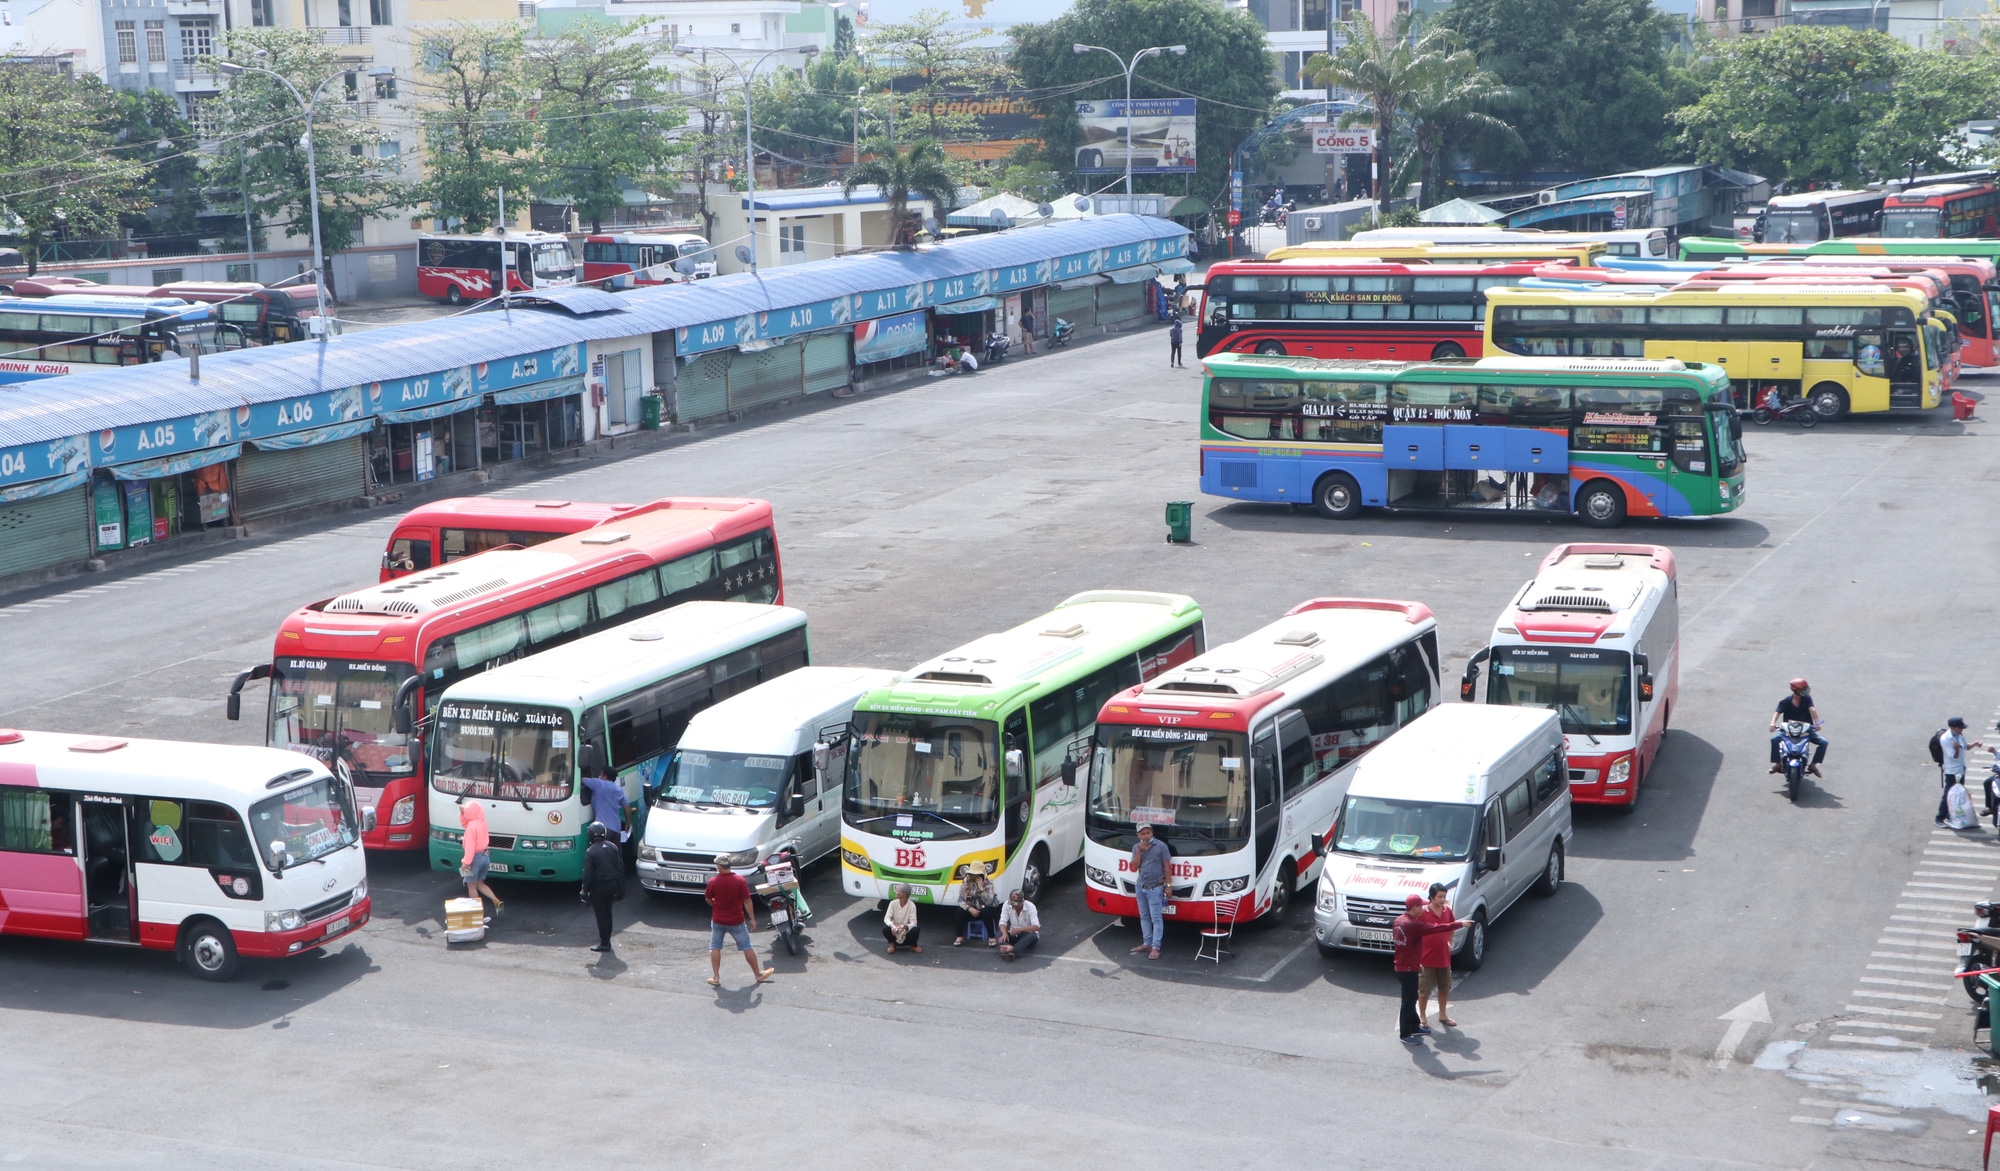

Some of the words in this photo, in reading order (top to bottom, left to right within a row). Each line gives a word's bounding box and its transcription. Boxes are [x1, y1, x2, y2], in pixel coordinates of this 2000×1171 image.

[1316, 133, 1355, 147] CỔNG
[1359, 136, 1369, 147] 5
[1117, 250, 1131, 264] A.15
[1067, 259, 1082, 274] A.14
[1010, 268, 1027, 285] A.13
[945, 280, 964, 298] A.12
[1330, 292, 1356, 301] KHÁCH
[877, 292, 896, 311] A.11
[790, 308, 812, 329] A.10
[702, 324, 725, 345] A.09
[0, 362, 29, 372] MINH
[35, 364, 69, 375] NGHĨA
[402, 379, 429, 402] A.07
[277, 400, 313, 426] A.06
[1303, 404, 1319, 416] GIA
[1320, 404, 1335, 416] LAI
[1393, 405, 1416, 423] QUẬN
[1418, 408, 1428, 419] 12
[1434, 405, 1452, 420] HÓC
[1453, 405, 1472, 420] MÔN
[137, 424, 176, 451] A.05
[442, 704, 459, 718] BẾN
[459, 707, 471, 719] XE
[471, 704, 494, 721] MIỀN
[525, 713, 547, 724] XUÂN
[547, 713, 563, 727] LỘC
[1158, 716, 1182, 725] VIP
[1131, 727, 1143, 737] BẾN
[1143, 729, 1151, 738] XE
[1151, 728, 1165, 739] MIỀN
[1165, 729, 1181, 740] ĐÔNG
[1184, 730, 1196, 741] TÂN
[1196, 732, 1208, 741] PHÚ
[536, 784, 551, 800] TÂN
[733, 793, 749, 805] RAY
[149, 834, 173, 846] WIFI
[895, 846, 926, 869] BÉ
[1344, 872, 1389, 887] Phương
[1394, 874, 1431, 891] Trang
[1365, 916, 1390, 925] Ford
